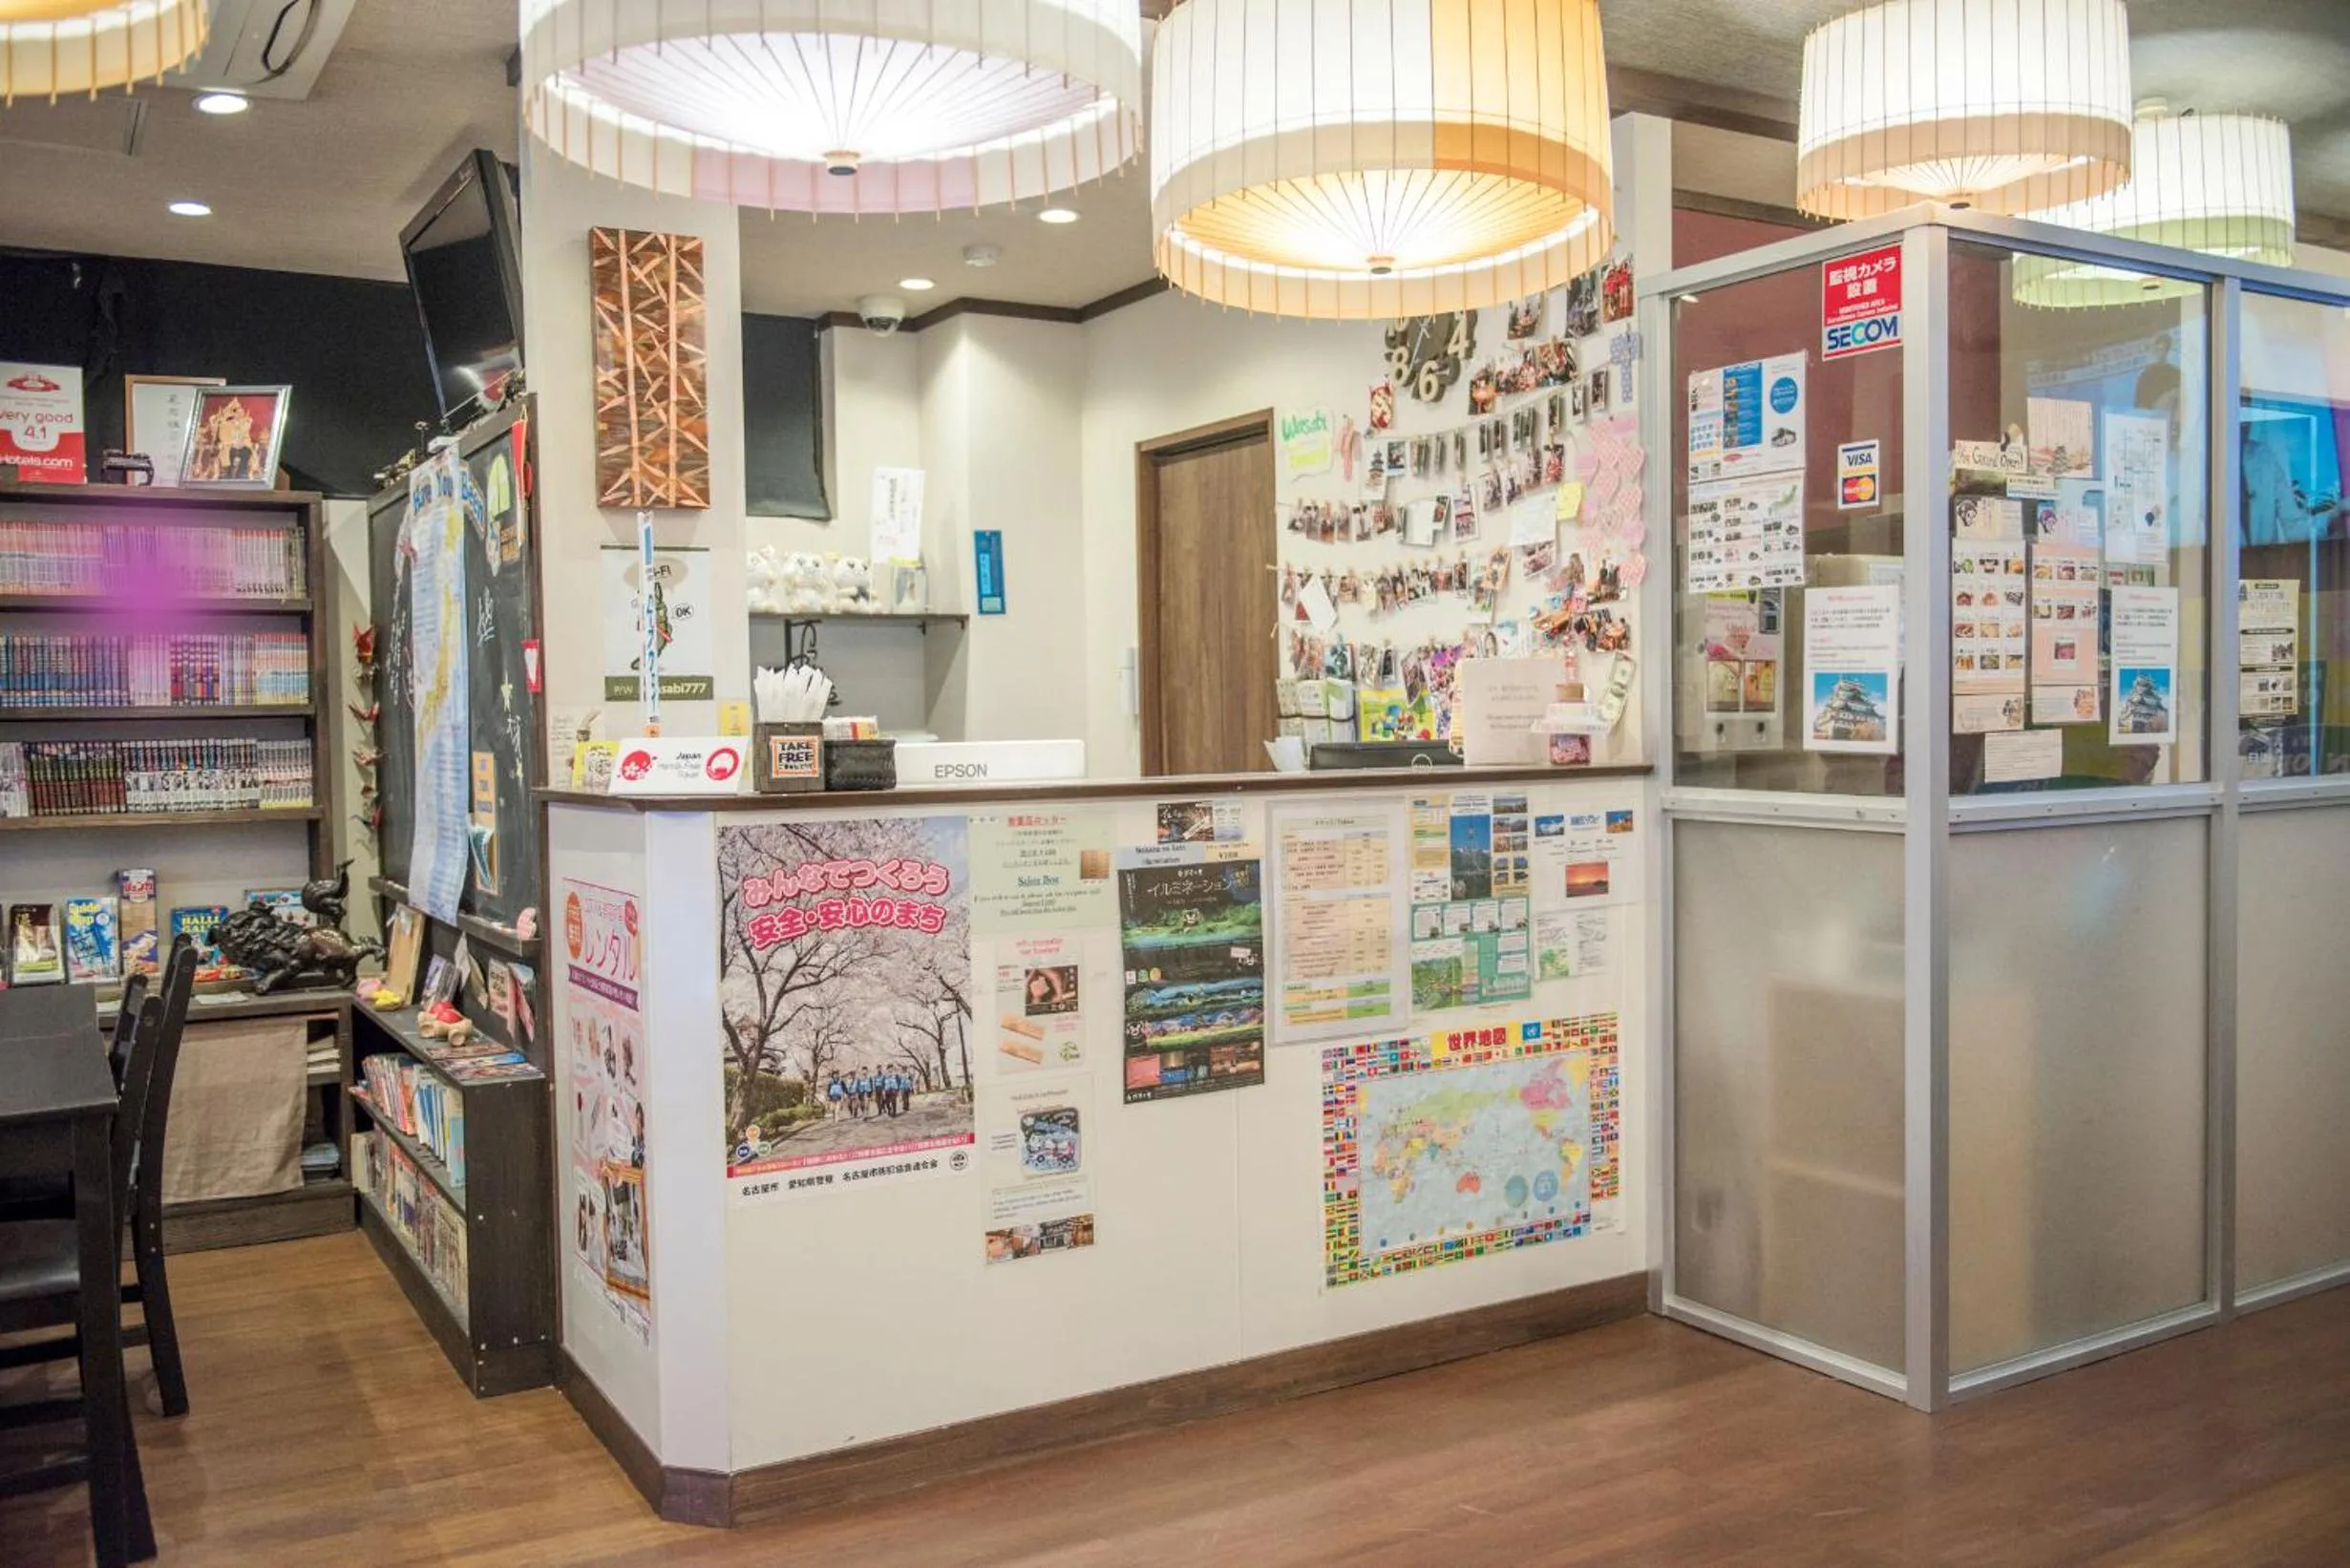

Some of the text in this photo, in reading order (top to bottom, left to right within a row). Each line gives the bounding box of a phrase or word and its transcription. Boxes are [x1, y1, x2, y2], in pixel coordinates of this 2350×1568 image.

[1827, 315, 1898, 350] SECOM
[1390, 346, 1409, 387] 8
[1418, 360, 1439, 402] 6
[35, 413, 74, 424] good
[25, 425, 47, 440] 4.1
[1846, 452, 1874, 467] VISA
[675, 605, 692, 619] OK
[659, 683, 708, 694] sabi777
[779, 741, 813, 752] TAKE
[778, 752, 814, 763] FREE
[935, 763, 987, 779] EPSON
[743, 858, 950, 908] みんなでつくろう
[1147, 877, 1232, 898] イルミネーション
[749, 898, 947, 949] 安全・安心のまち
[1448, 1027, 1507, 1051] 世界地図
